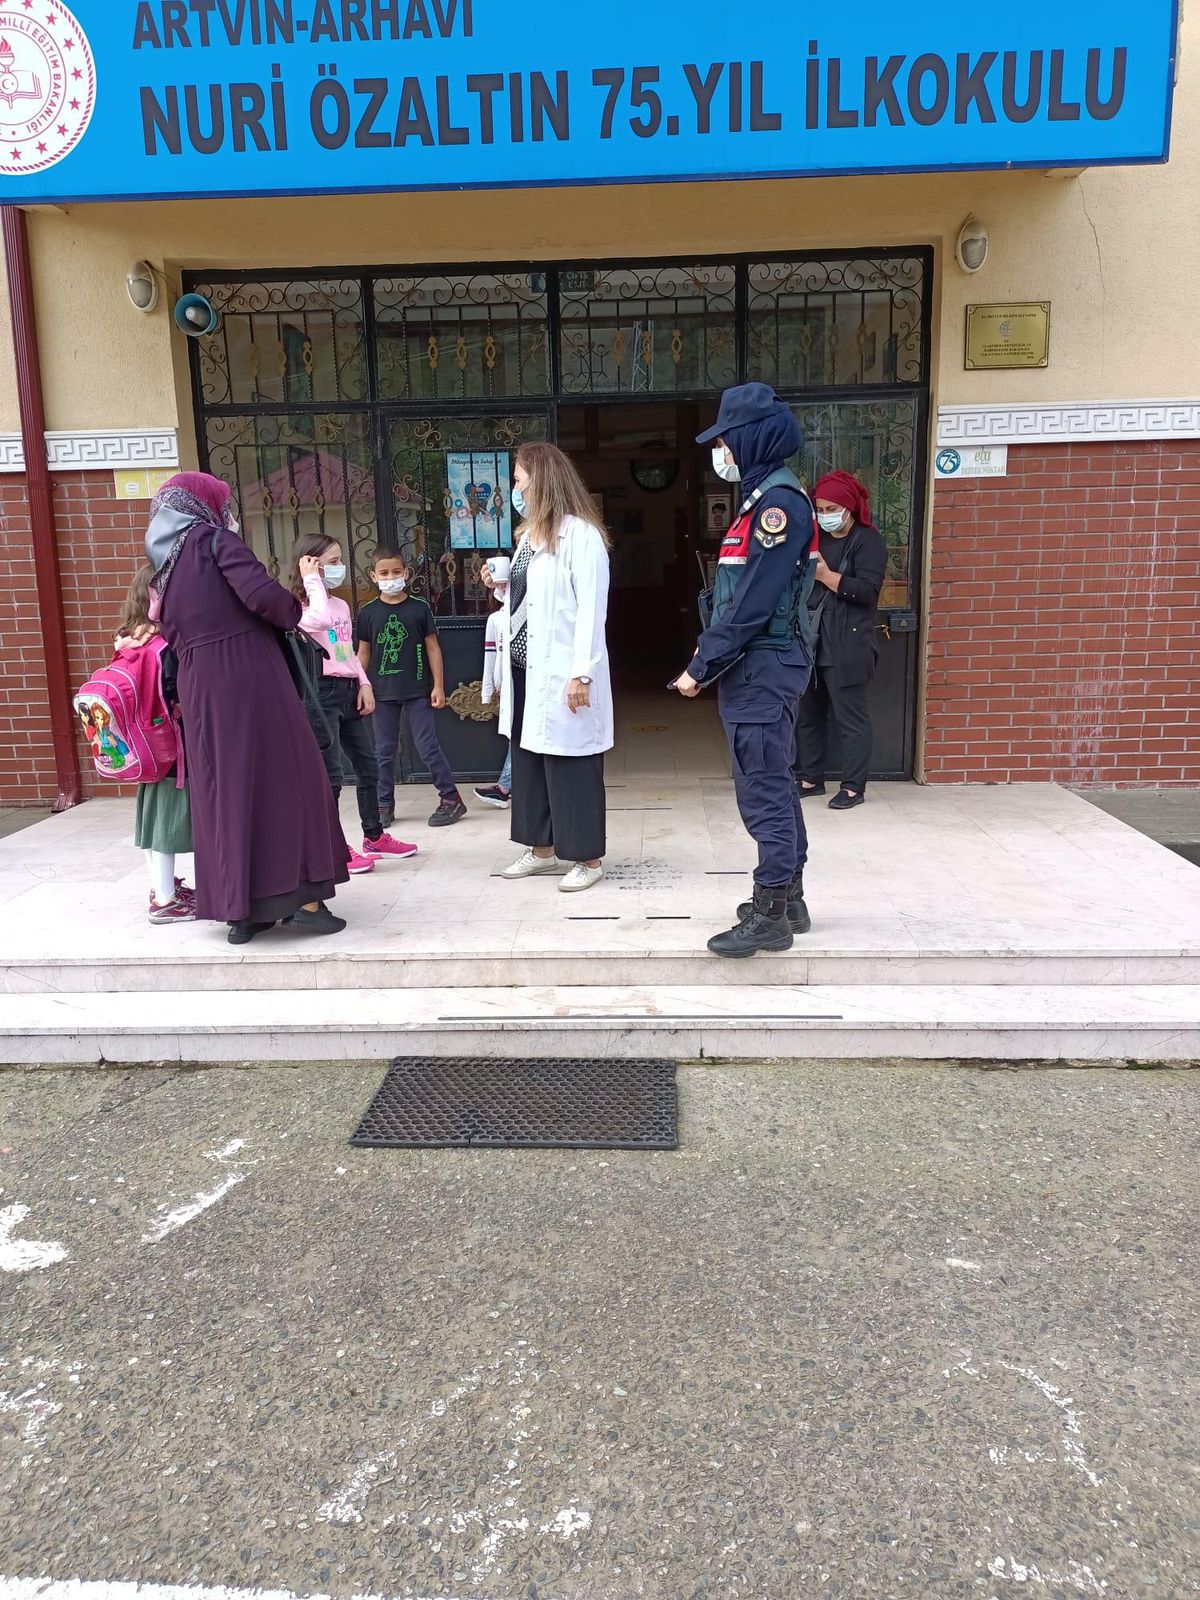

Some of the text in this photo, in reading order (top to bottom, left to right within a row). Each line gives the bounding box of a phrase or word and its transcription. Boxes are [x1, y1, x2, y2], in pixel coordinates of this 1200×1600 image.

[32, 28, 60, 69] EĞİTİM
[26, 73, 62, 134] BAKANLIĞI
[140, 41, 1126, 155] NURİ ÖZALTIN 75.YIL İLKOKULU
